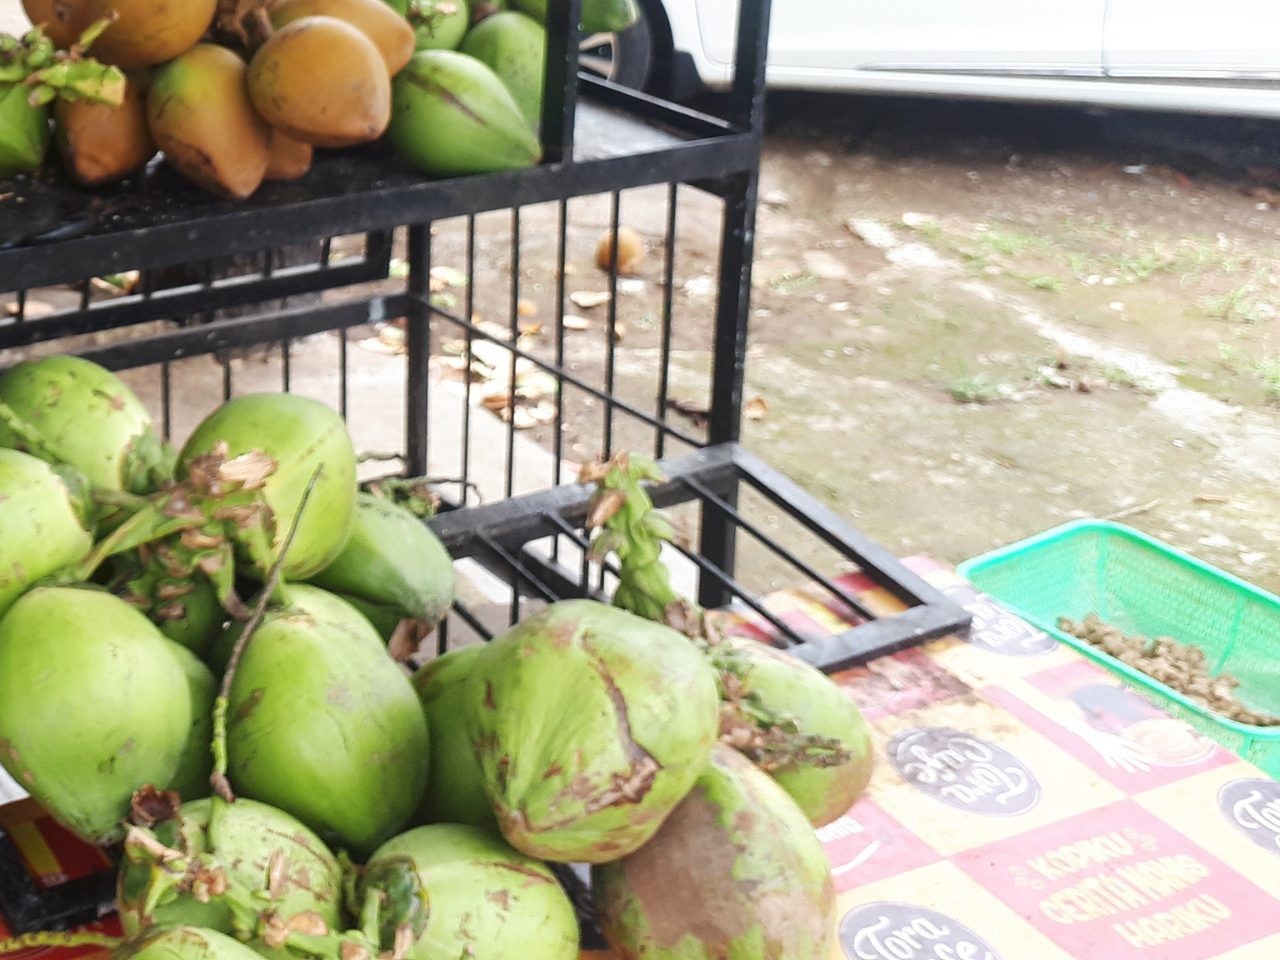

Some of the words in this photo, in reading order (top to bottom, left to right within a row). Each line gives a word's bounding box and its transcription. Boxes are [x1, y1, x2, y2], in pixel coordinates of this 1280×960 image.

[940, 762, 1028, 806] Tora
[1026, 832, 1134, 881] KOPIKU
[1039, 872, 1151, 924] CERITA
[1111, 893, 1232, 948] HARIKU
